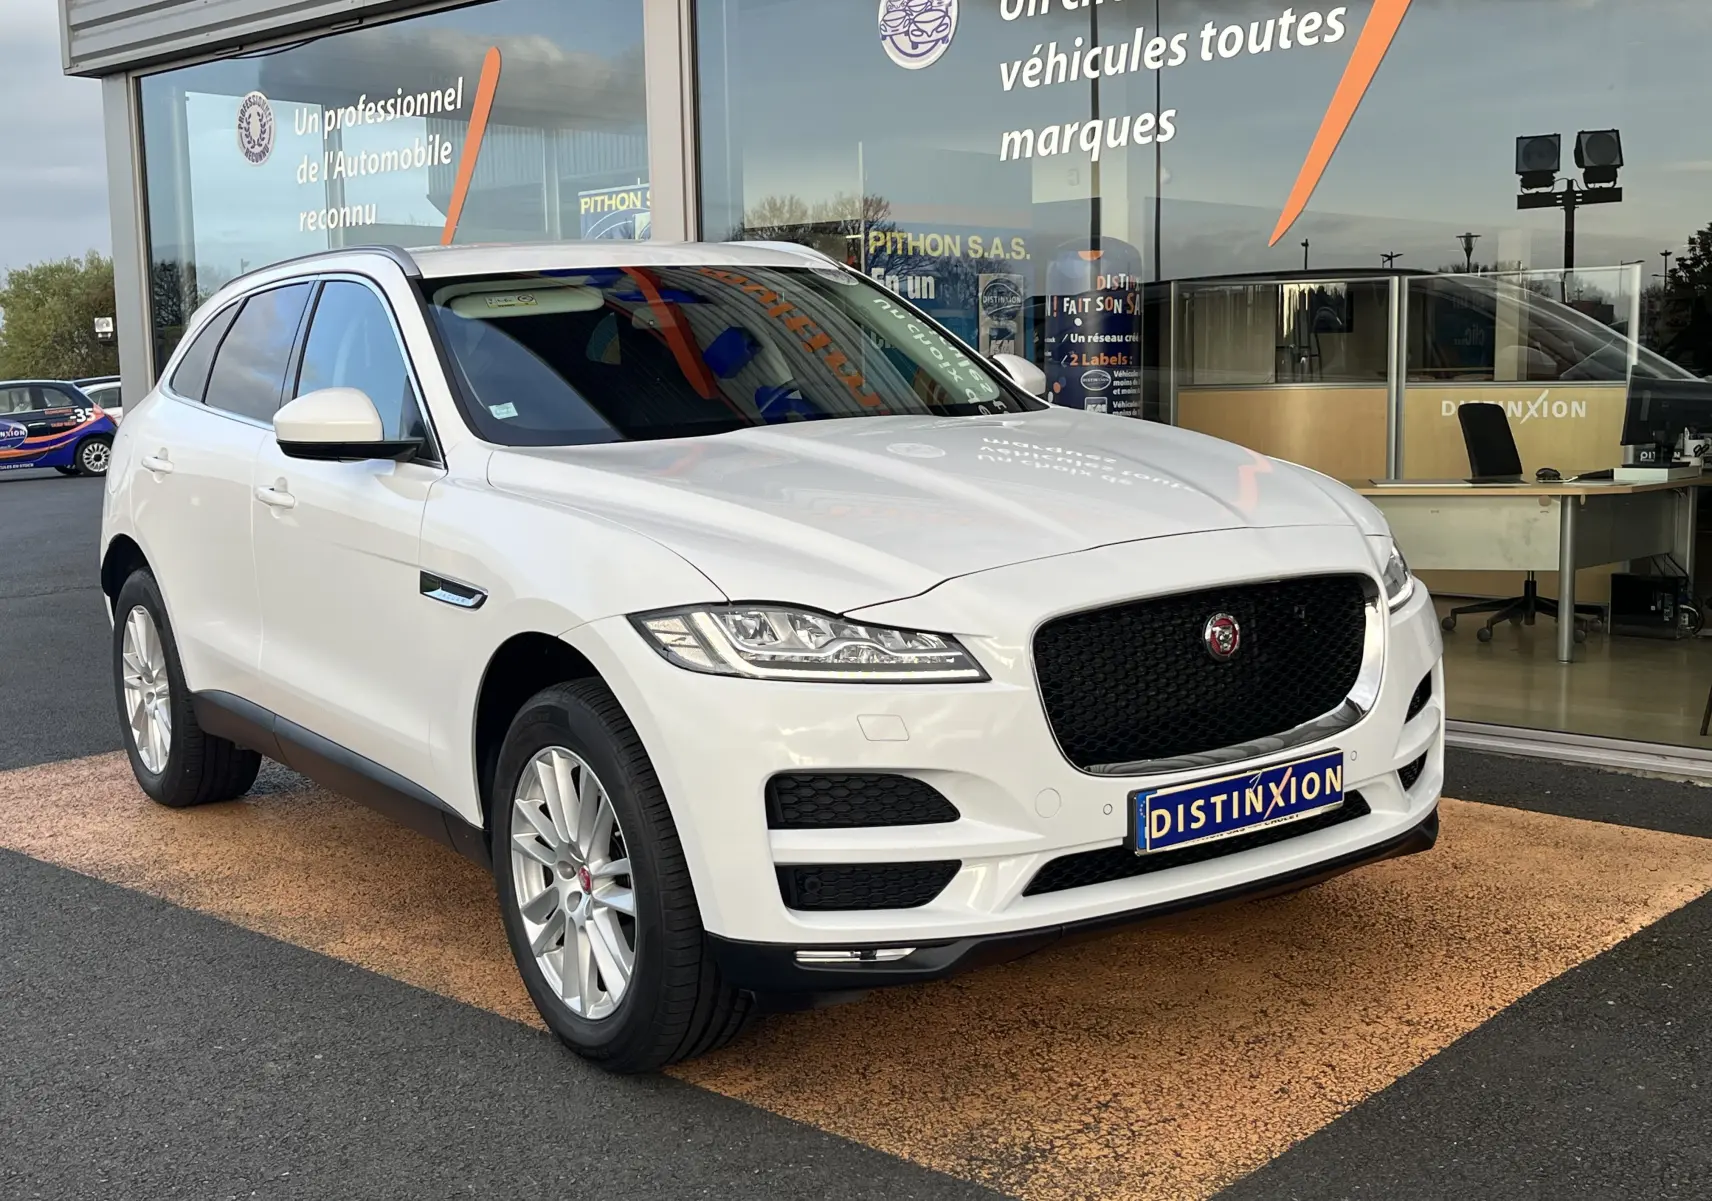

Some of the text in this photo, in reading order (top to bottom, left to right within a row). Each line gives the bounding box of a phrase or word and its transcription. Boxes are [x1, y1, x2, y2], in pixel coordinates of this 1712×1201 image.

[1000, 7, 1346, 91] véhicules toutes
[295, 76, 463, 139] Un professionnel
[1000, 108, 1177, 162] marques
[296, 134, 452, 184] de l'Automobile
[580, 190, 642, 215] PITHON
[299, 203, 377, 232] reconnu
[869, 231, 1031, 260] PITHON S.A.S.
[907, 275, 935, 299] un
[1063, 297, 1092, 315] FAIT
[1095, 296, 1123, 314] SON
[1070, 333, 1085, 343] Un
[1087, 332, 1123, 343] réseau
[1069, 353, 1079, 366] 2
[1151, 765, 1342, 839] DISTINXION
